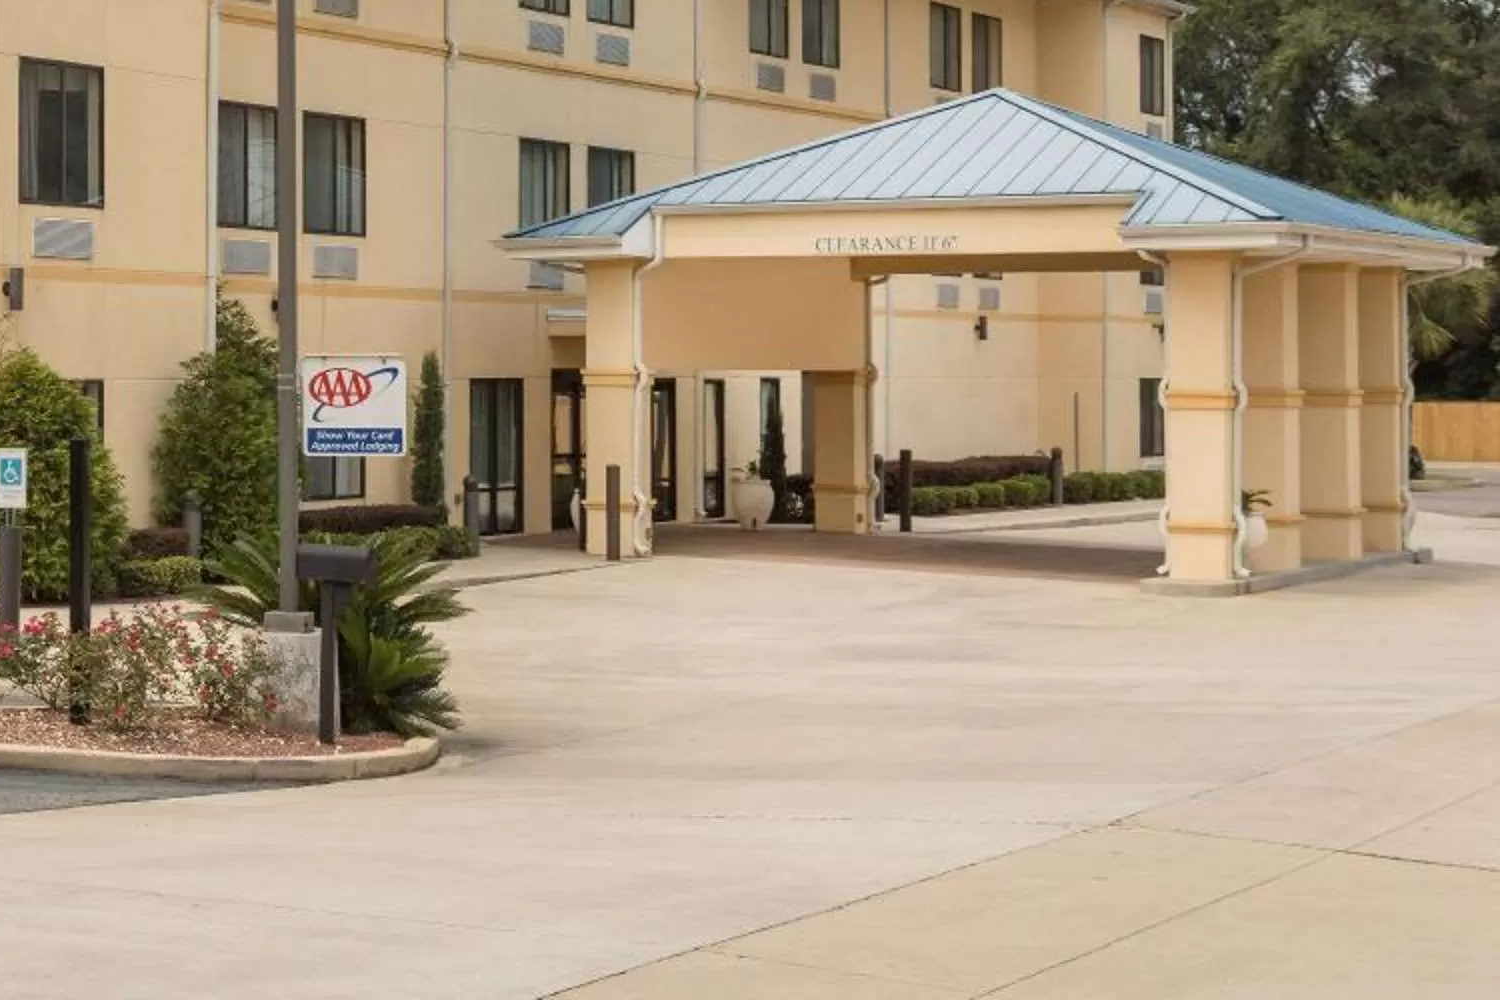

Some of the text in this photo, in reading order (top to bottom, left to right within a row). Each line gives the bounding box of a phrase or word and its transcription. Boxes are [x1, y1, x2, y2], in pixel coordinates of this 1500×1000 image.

[815, 236, 917, 252] CLEARANCE
[315, 369, 366, 407] AAA
[316, 431, 395, 441] Show Your Card
[311, 441, 400, 452] Approved Lodging
